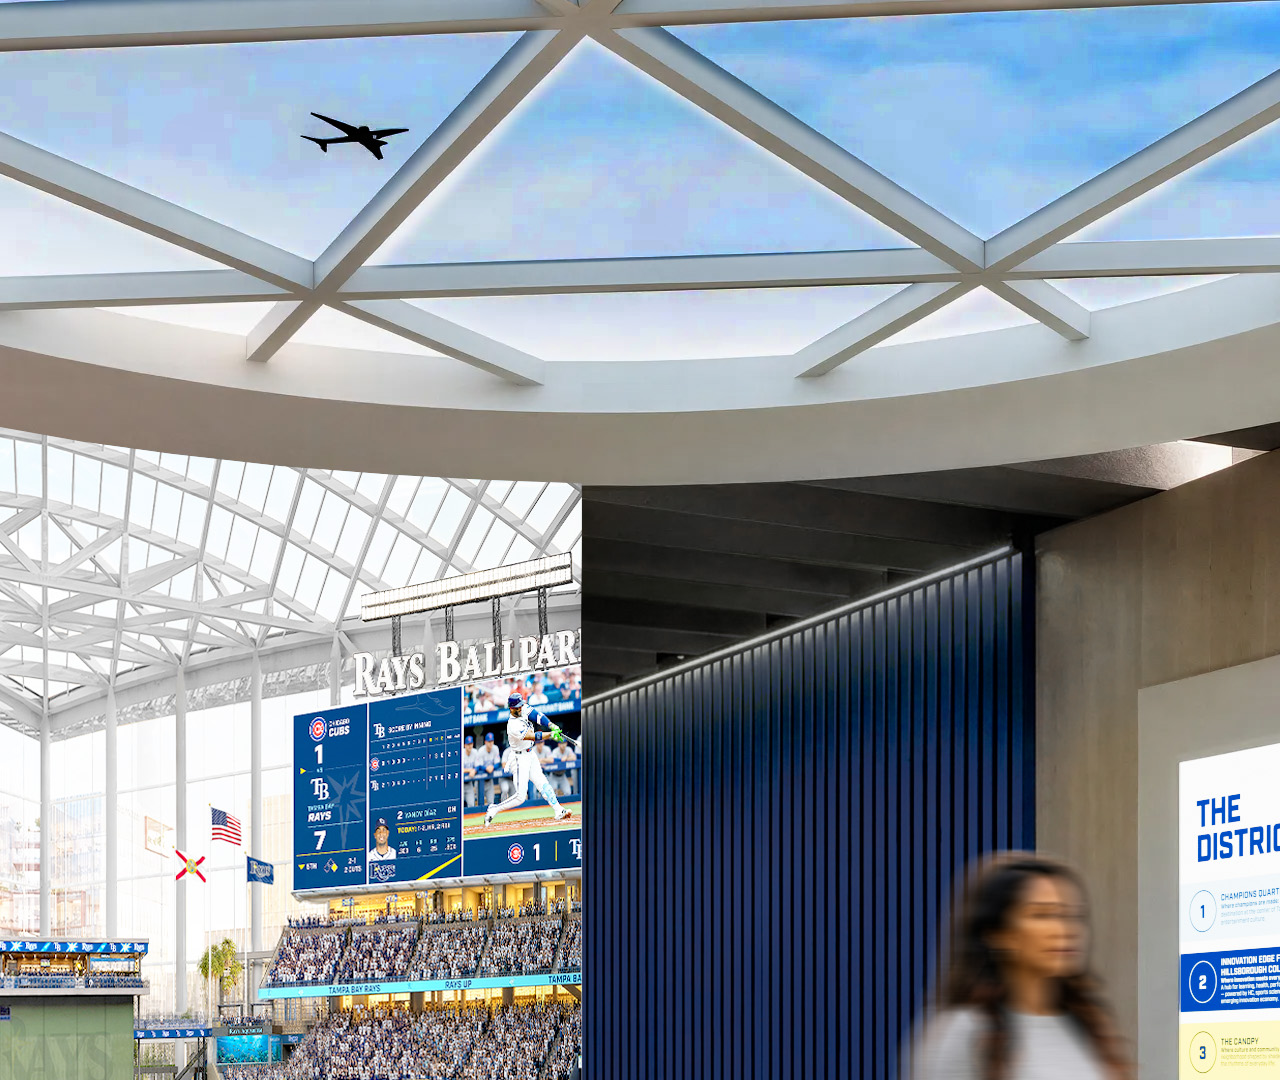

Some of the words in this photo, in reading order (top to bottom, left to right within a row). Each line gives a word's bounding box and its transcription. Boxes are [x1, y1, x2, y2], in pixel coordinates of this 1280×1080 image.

[353, 651, 426, 697] RAYS
[436, 628, 581, 684] BALLPAR
[328, 725, 350, 738] CUBS
[314, 744, 323, 764] 1
[307, 810, 332, 823] RAYS
[397, 811, 403, 820] 2
[1197, 794, 1241, 827] THE
[313, 829, 327, 850] 7
[533, 843, 540, 861] 1
[1221, 890, 1257, 901] CHAMPIONS
[1200, 904, 1205, 919] 1
[1221, 956, 1257, 966] INNOVATION
[1258, 954, 1275, 964] EDGE
[1221, 966, 1267, 976] HILLSBOROUGH
[445, 980, 461, 989] RAYS
[464, 980, 472, 988] UP
[548, 975, 570, 984] TAMPA
[1198, 975, 1207, 990] 2
[329, 986, 350, 995] TAMPA
[351, 985, 363, 993] BAY
[364, 984, 381, 993] RAYS
[1199, 1046, 1206, 1060] 3
